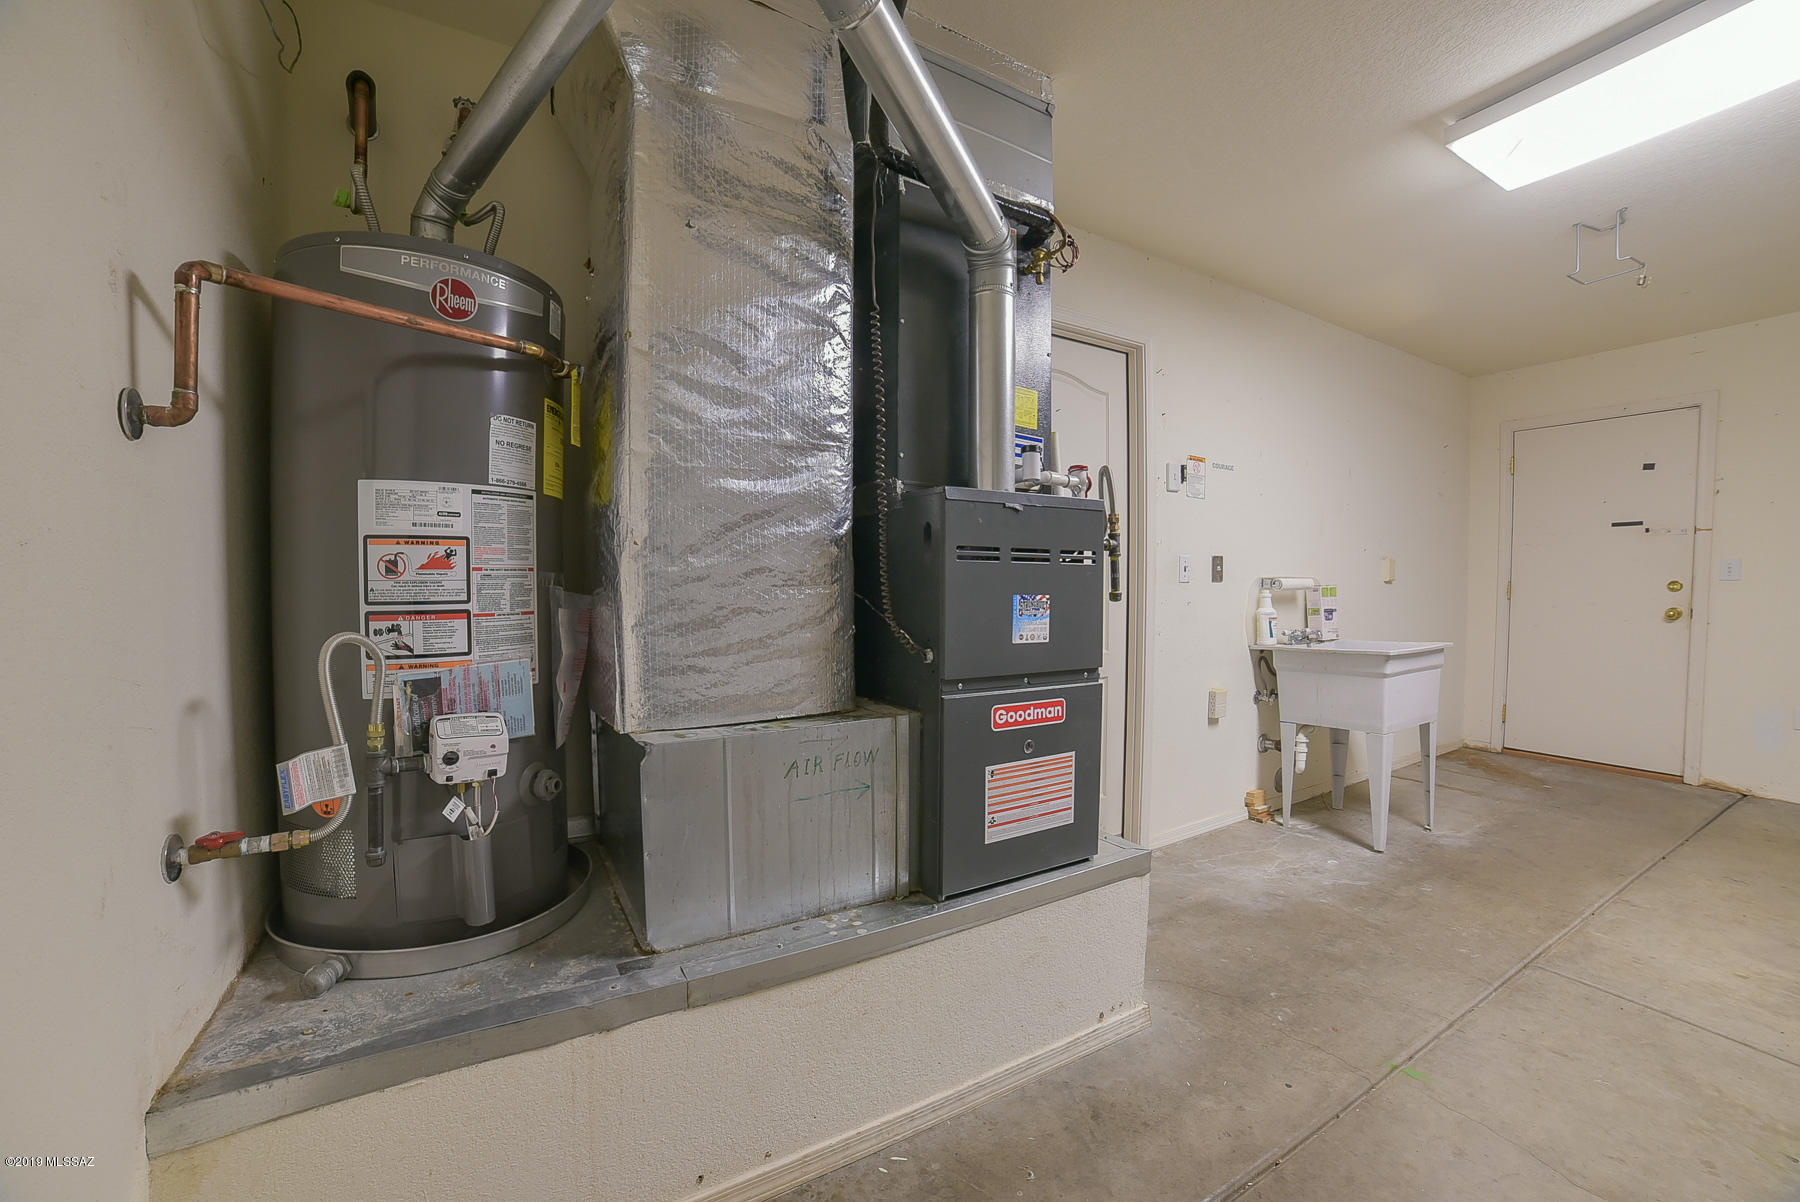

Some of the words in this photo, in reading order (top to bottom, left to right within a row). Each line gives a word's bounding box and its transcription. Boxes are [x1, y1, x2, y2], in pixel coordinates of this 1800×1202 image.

[401, 255, 506, 290] PERFORMANCE
[436, 277, 476, 314] Rheem
[503, 416, 514, 425] NOT
[515, 420, 535, 429] RETURN
[495, 439, 505, 447] NO
[1212, 462, 1235, 472] COURAGE
[995, 705, 1062, 724] Goodman
[784, 755, 824, 779] AIR
[833, 747, 879, 772] FLOW
[280, 768, 291, 809] EASYFLEX
